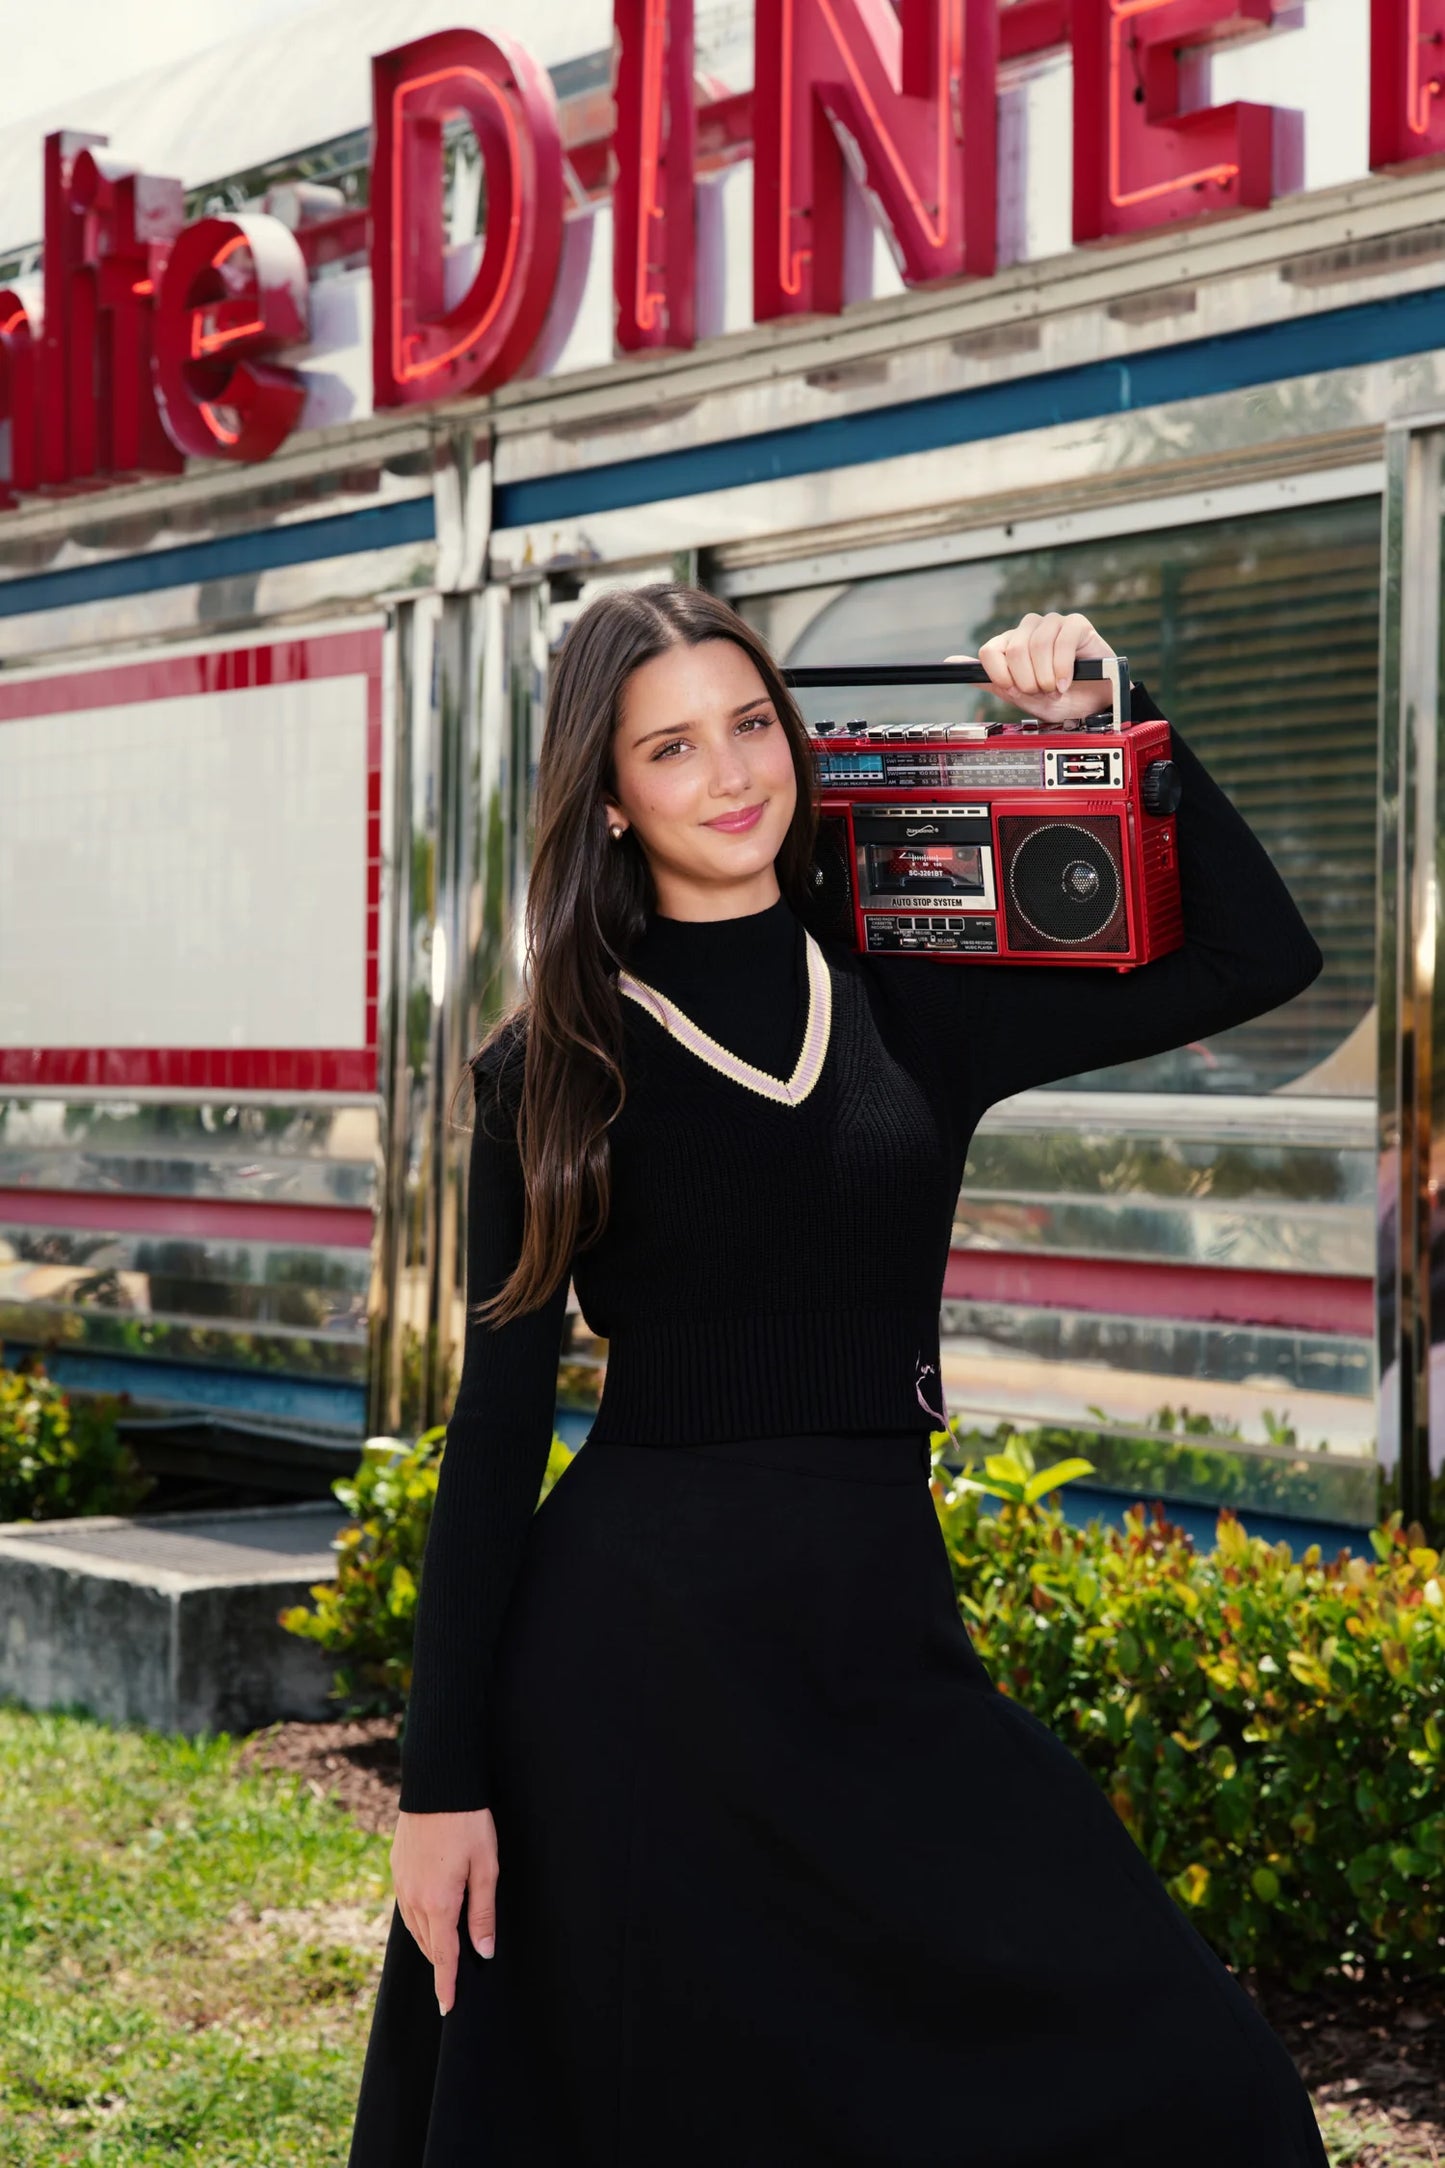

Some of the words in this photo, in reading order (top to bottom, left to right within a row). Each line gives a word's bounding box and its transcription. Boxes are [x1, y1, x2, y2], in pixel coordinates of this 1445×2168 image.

[371, 0, 1445, 412] DINE
[892, 898, 911, 906] AUTO
[912, 898, 931, 906] STOP
[933, 898, 962, 907] SYSTEM
